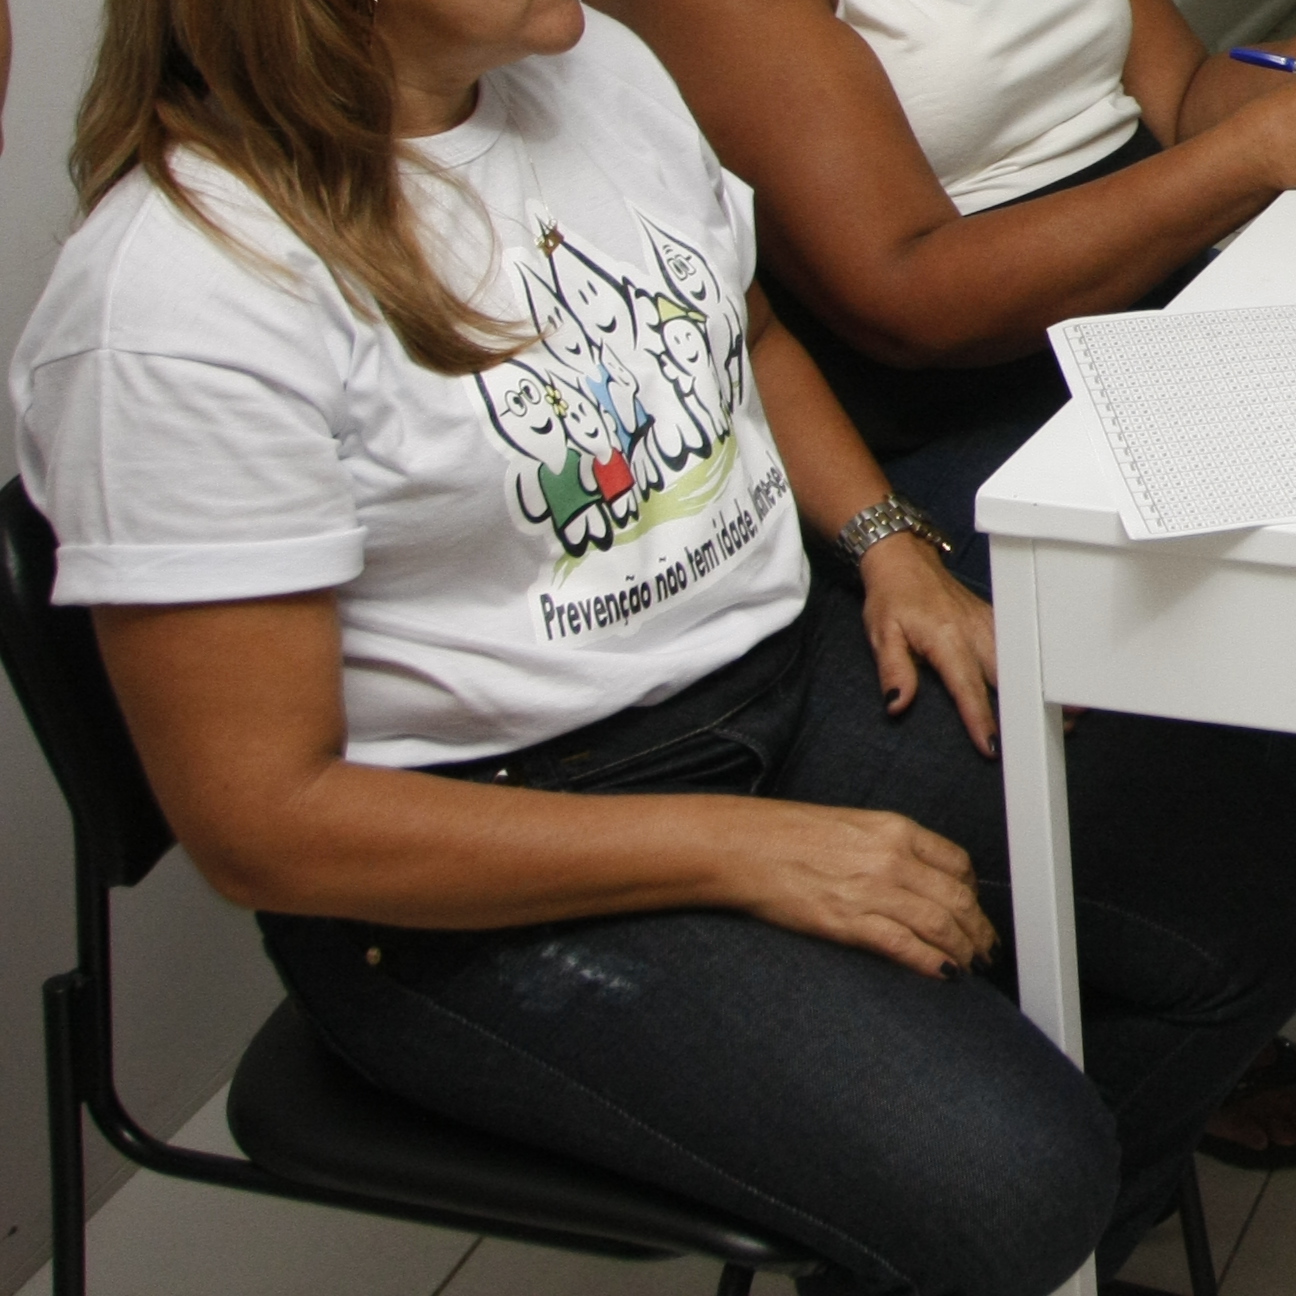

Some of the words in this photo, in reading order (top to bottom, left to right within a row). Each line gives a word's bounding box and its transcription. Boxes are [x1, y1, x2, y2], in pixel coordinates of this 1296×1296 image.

[539, 574, 652, 641] Prevenção
[654, 556, 688, 603] não
[684, 539, 720, 582] tem
[712, 497, 759, 561] idade.
